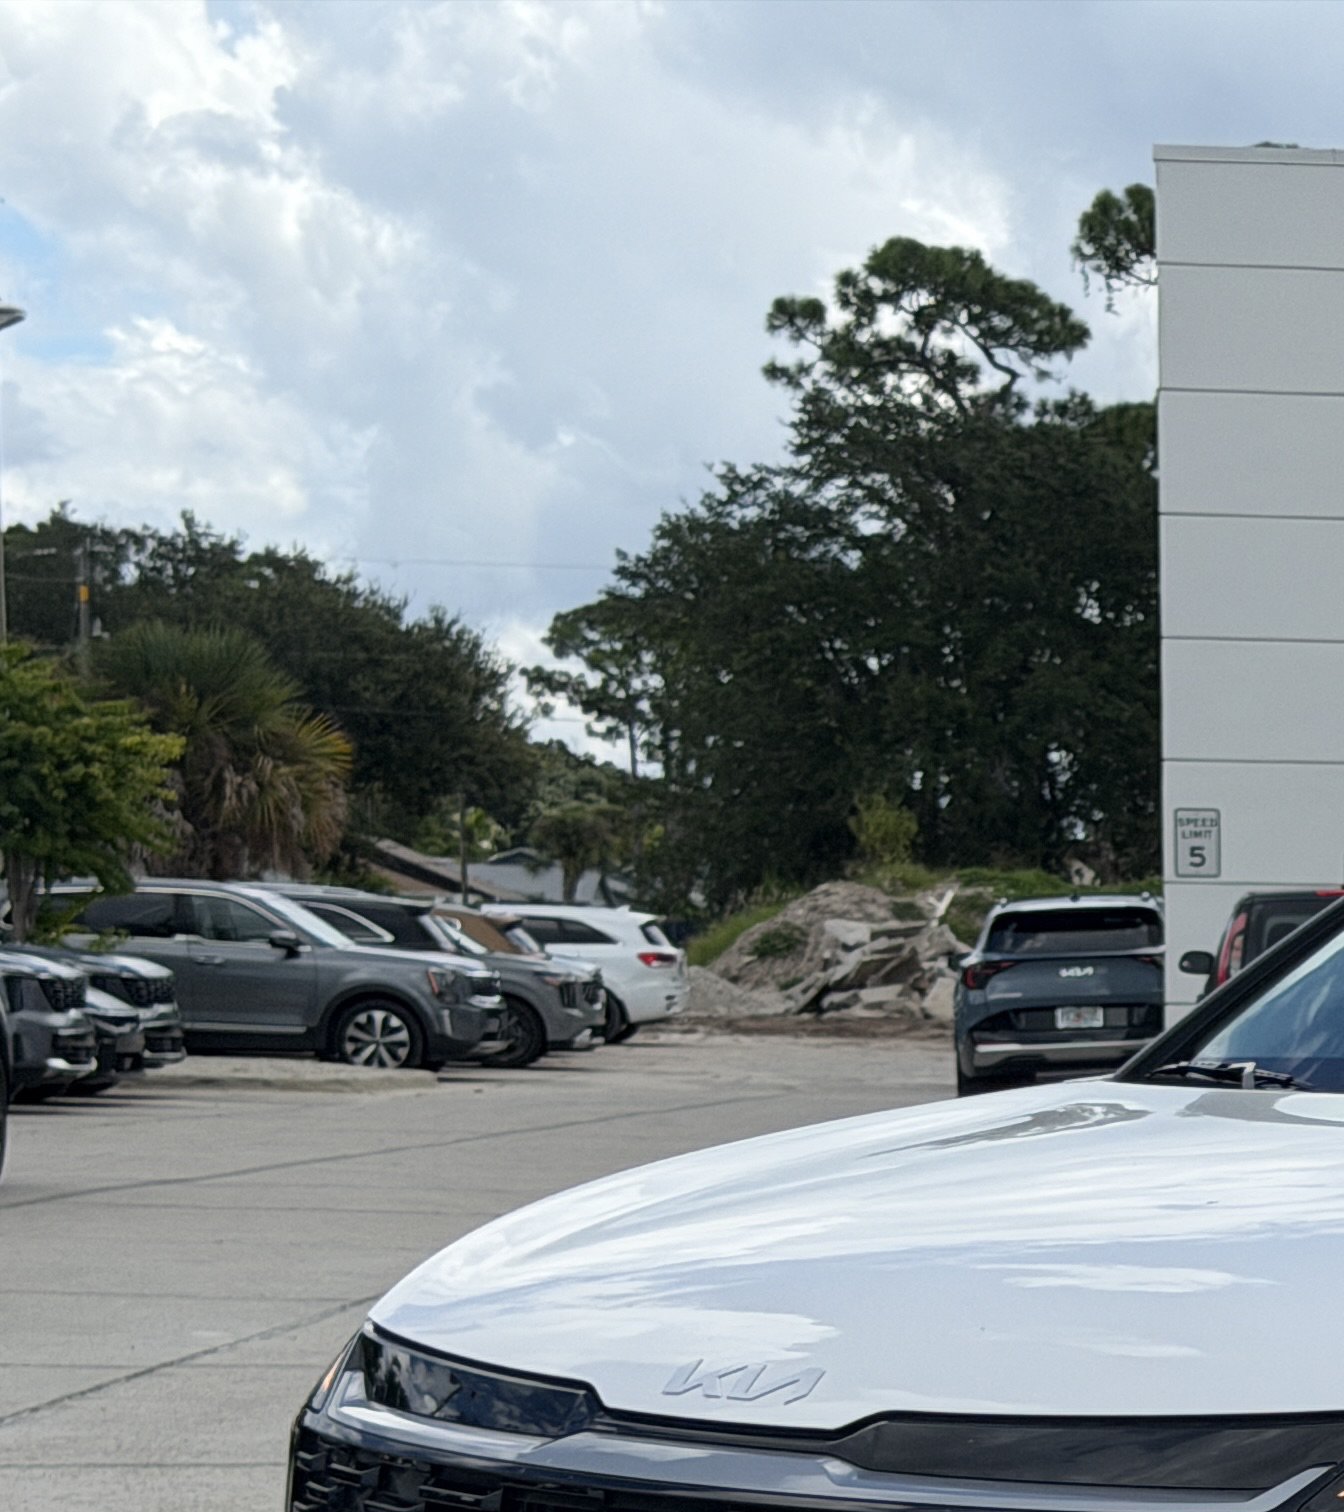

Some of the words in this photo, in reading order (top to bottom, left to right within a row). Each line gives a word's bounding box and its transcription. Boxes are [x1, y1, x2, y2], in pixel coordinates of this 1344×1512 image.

[1178, 817, 1218, 828] SPEED
[1182, 830, 1212, 839] LIMIT
[1189, 846, 1207, 868] 5
